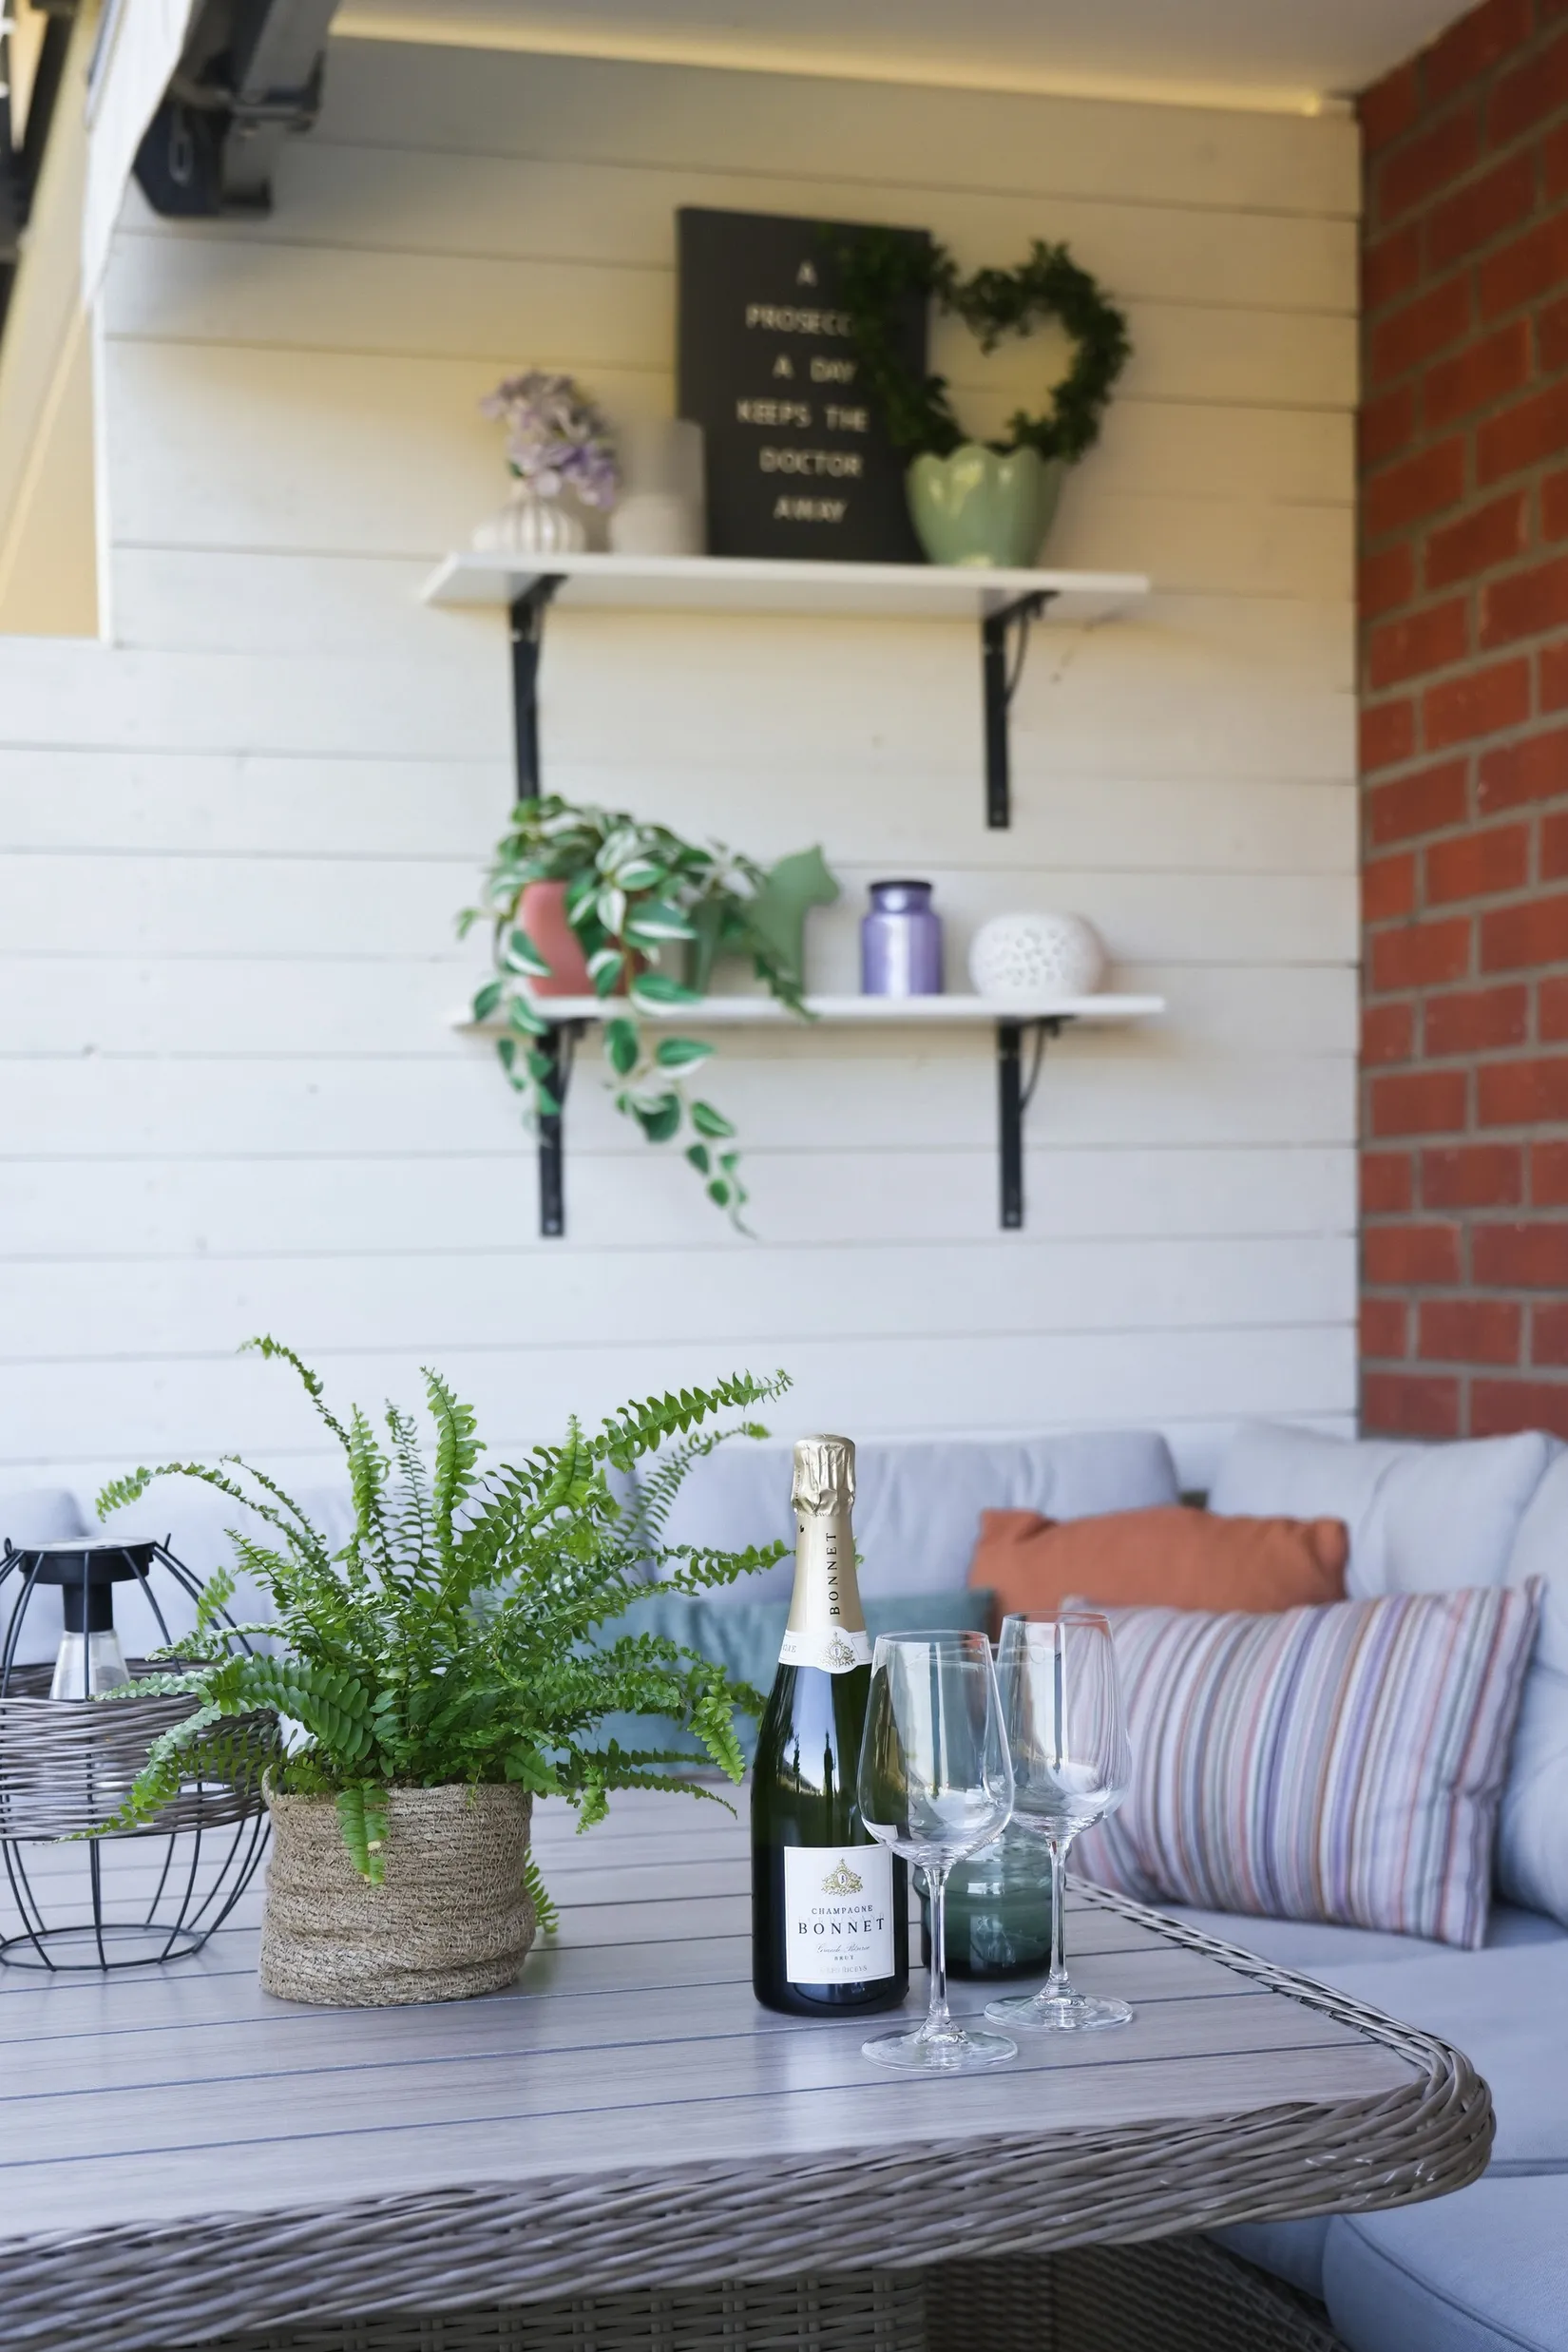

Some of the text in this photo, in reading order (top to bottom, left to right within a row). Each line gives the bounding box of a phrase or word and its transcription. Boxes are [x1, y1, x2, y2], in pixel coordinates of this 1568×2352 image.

[796, 259, 817, 286] A
[745, 303, 853, 338] PROSECC
[772, 354, 858, 384] A DAY
[736, 397, 869, 432] KEEPS THE
[759, 446, 863, 477] DOCTOR
[773, 496, 848, 523] AWAY
[826, 1533, 840, 1616] BONNET
[811, 1904, 873, 1915] CHAMPAGNE
[798, 1918, 885, 1935] BONNET
